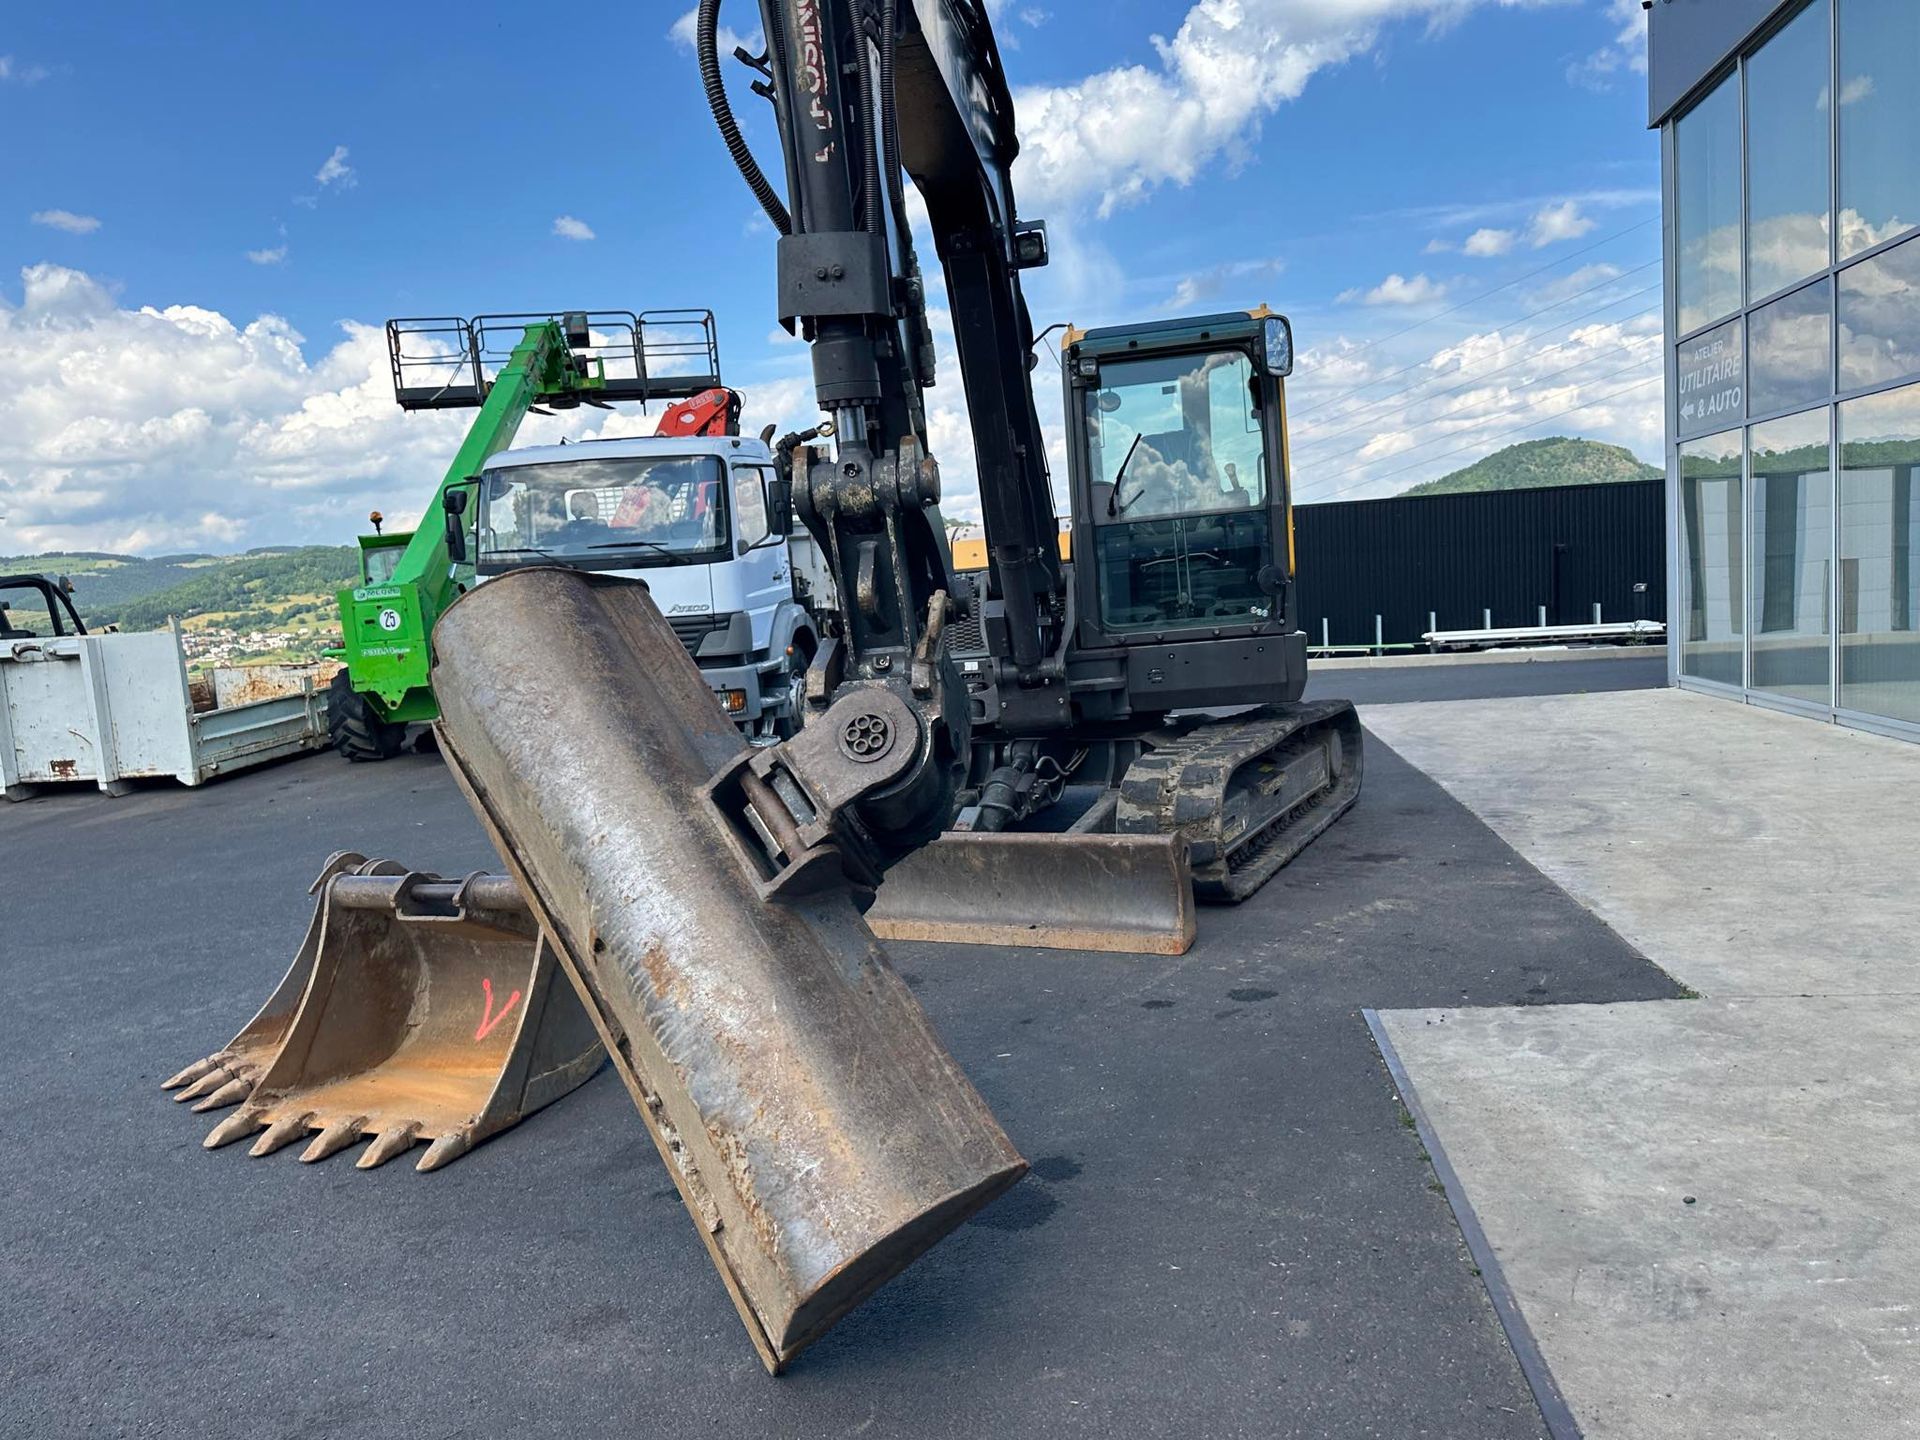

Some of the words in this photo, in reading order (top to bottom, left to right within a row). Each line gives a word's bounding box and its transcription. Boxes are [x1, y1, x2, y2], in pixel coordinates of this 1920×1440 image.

[1694, 340, 1724, 361] ATELIER
[1679, 355, 1741, 394] UTILITAIRE
[1697, 398, 1705, 419] &
[1707, 386, 1741, 416] AUTO
[384, 611, 396, 628] 25
